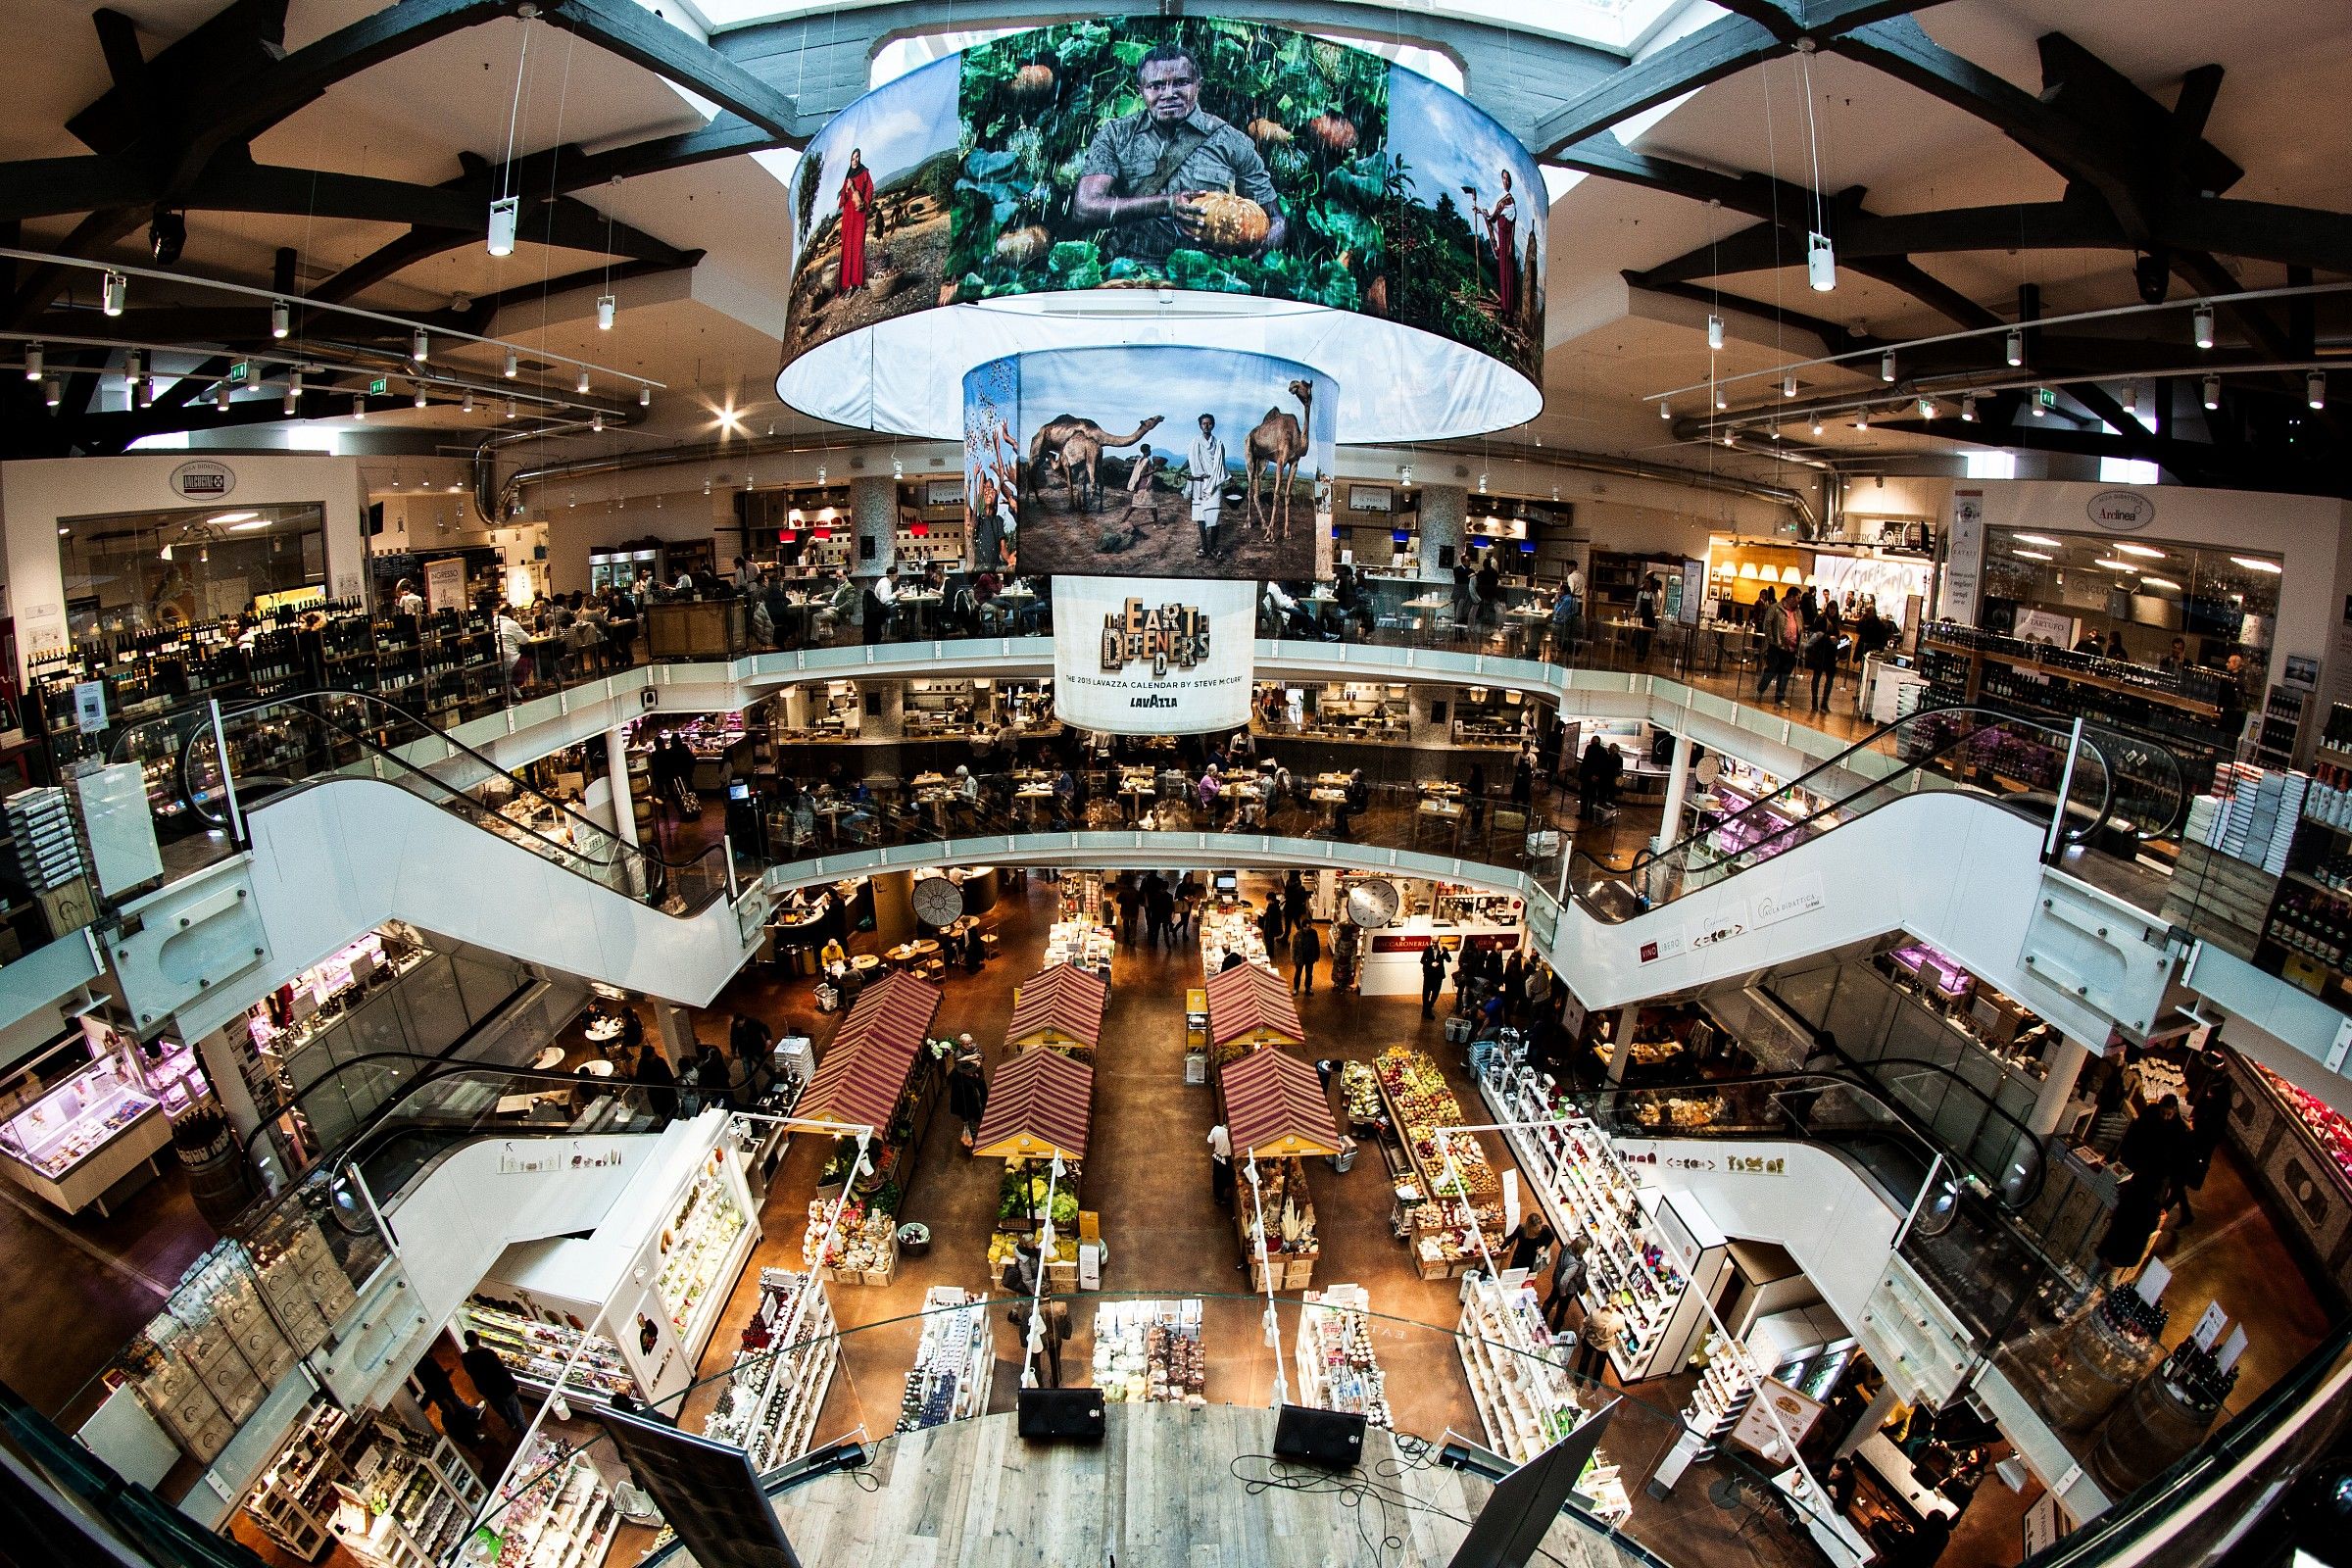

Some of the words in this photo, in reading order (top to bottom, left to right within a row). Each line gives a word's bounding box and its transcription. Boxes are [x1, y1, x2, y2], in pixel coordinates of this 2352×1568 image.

[1124, 598, 1210, 637] EARTH
[1066, 674, 1076, 683] THE
[1093, 679, 1128, 688] LAVAZZA
[1194, 679, 1217, 688] STEVE
[1130, 694, 1178, 709] LAVAZZA
[1642, 947, 1657, 958] VINO
[1658, 938, 1680, 954] LIBERO
